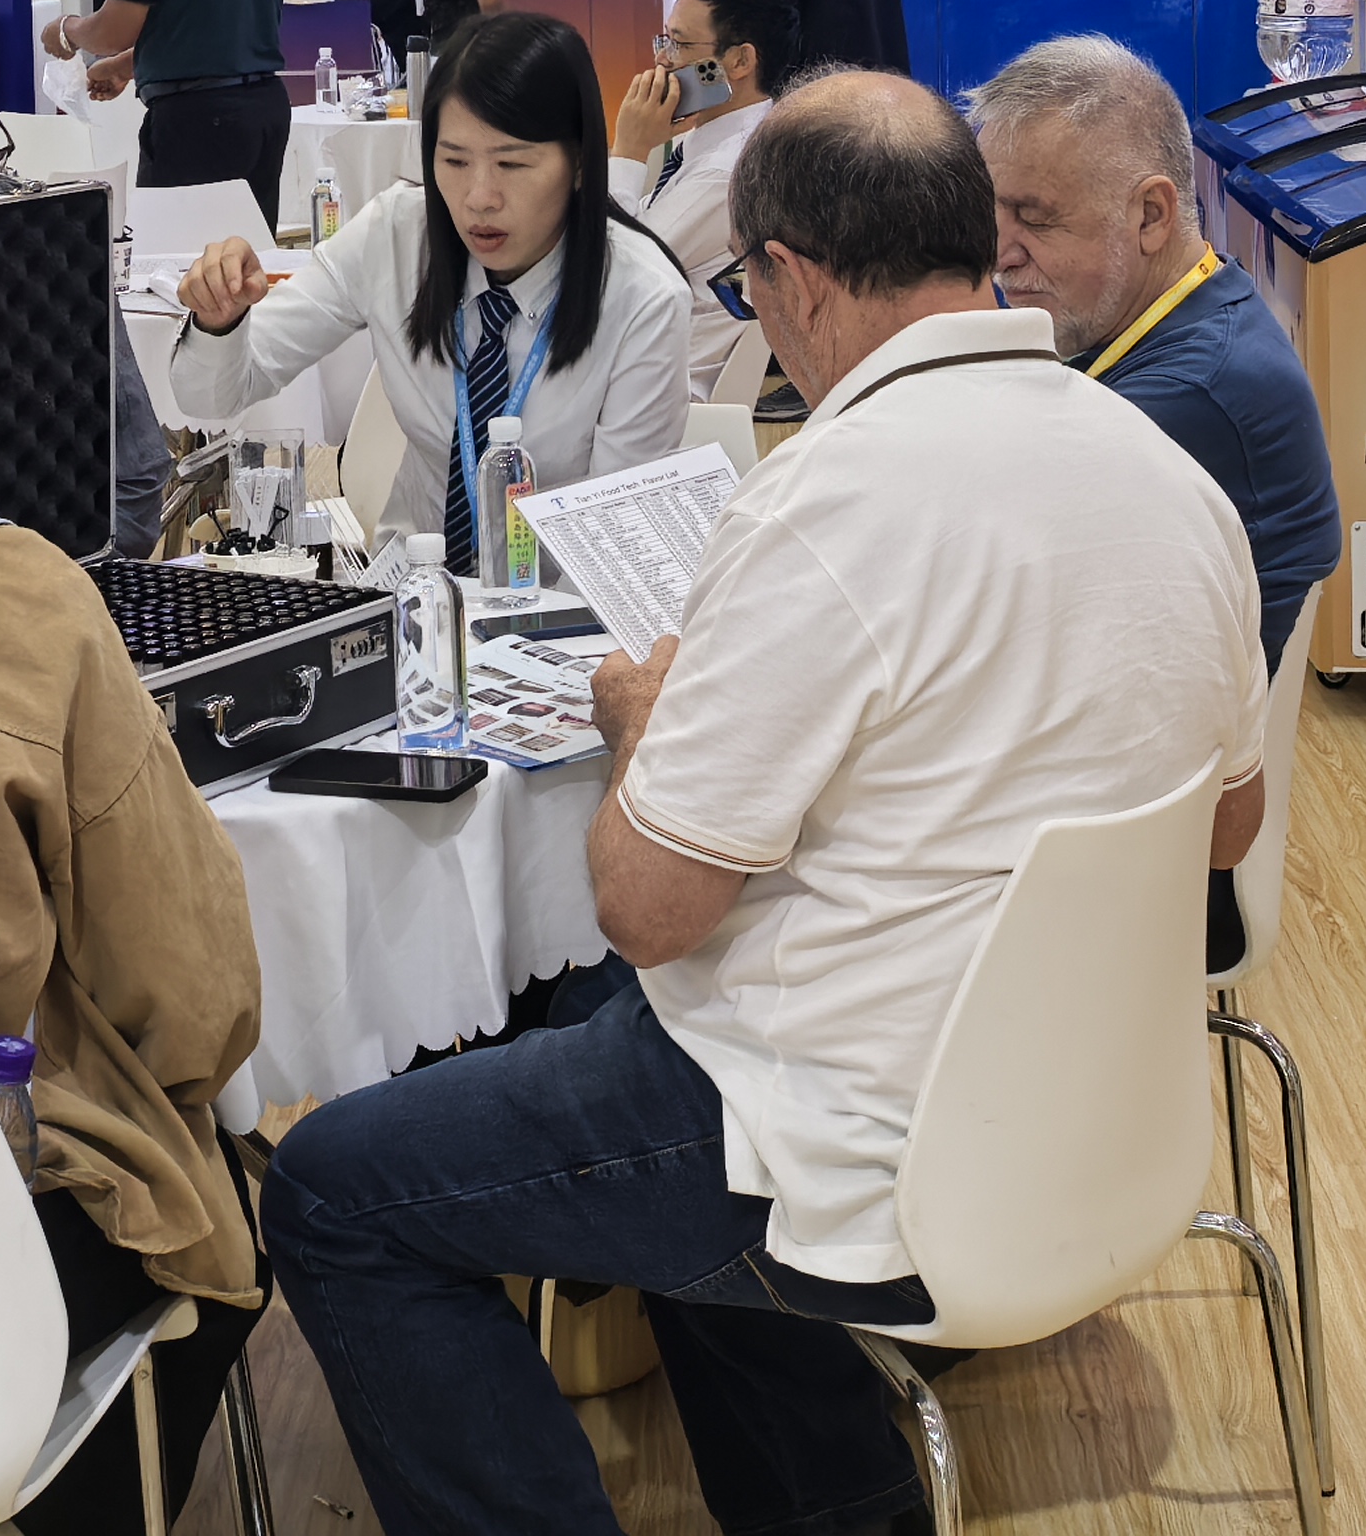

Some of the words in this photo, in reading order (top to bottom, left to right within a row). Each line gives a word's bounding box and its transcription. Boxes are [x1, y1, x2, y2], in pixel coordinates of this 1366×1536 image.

[575, 494, 592, 504] Tian
[601, 486, 621, 498] Food
[642, 474, 664, 486] Flavor
[666, 469, 679, 480] List
